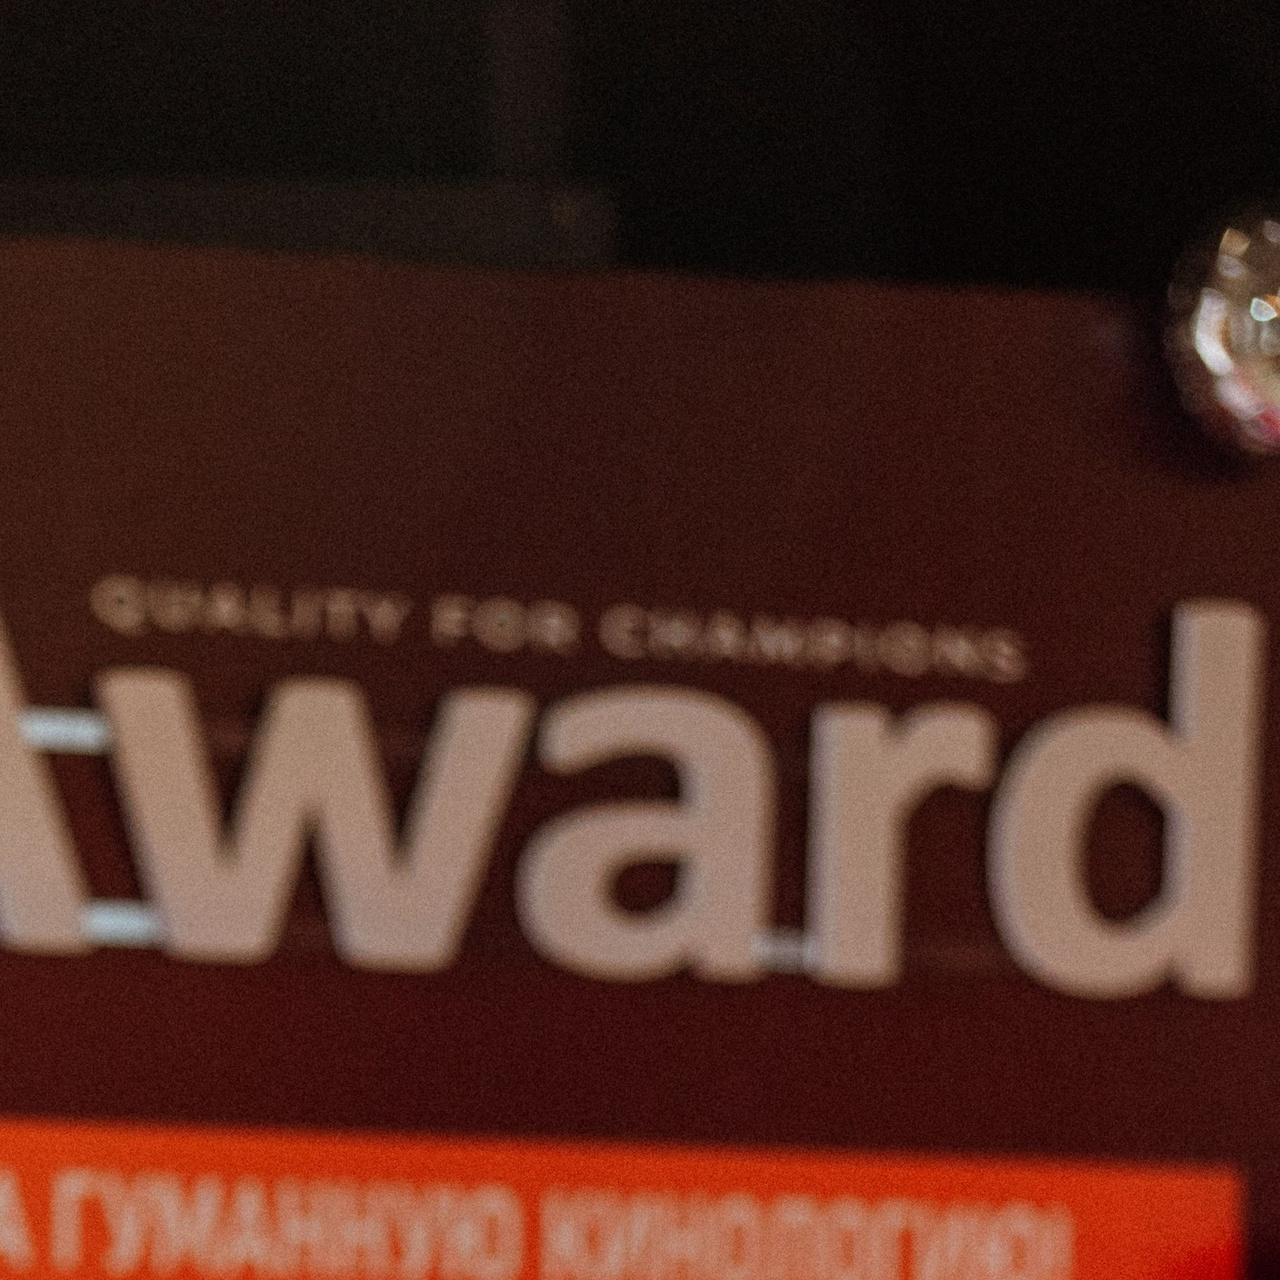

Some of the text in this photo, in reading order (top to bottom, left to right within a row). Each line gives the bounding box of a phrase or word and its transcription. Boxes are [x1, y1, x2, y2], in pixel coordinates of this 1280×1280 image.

[90, 575, 1028, 684] QUALITY FOR CHAMPIONS
